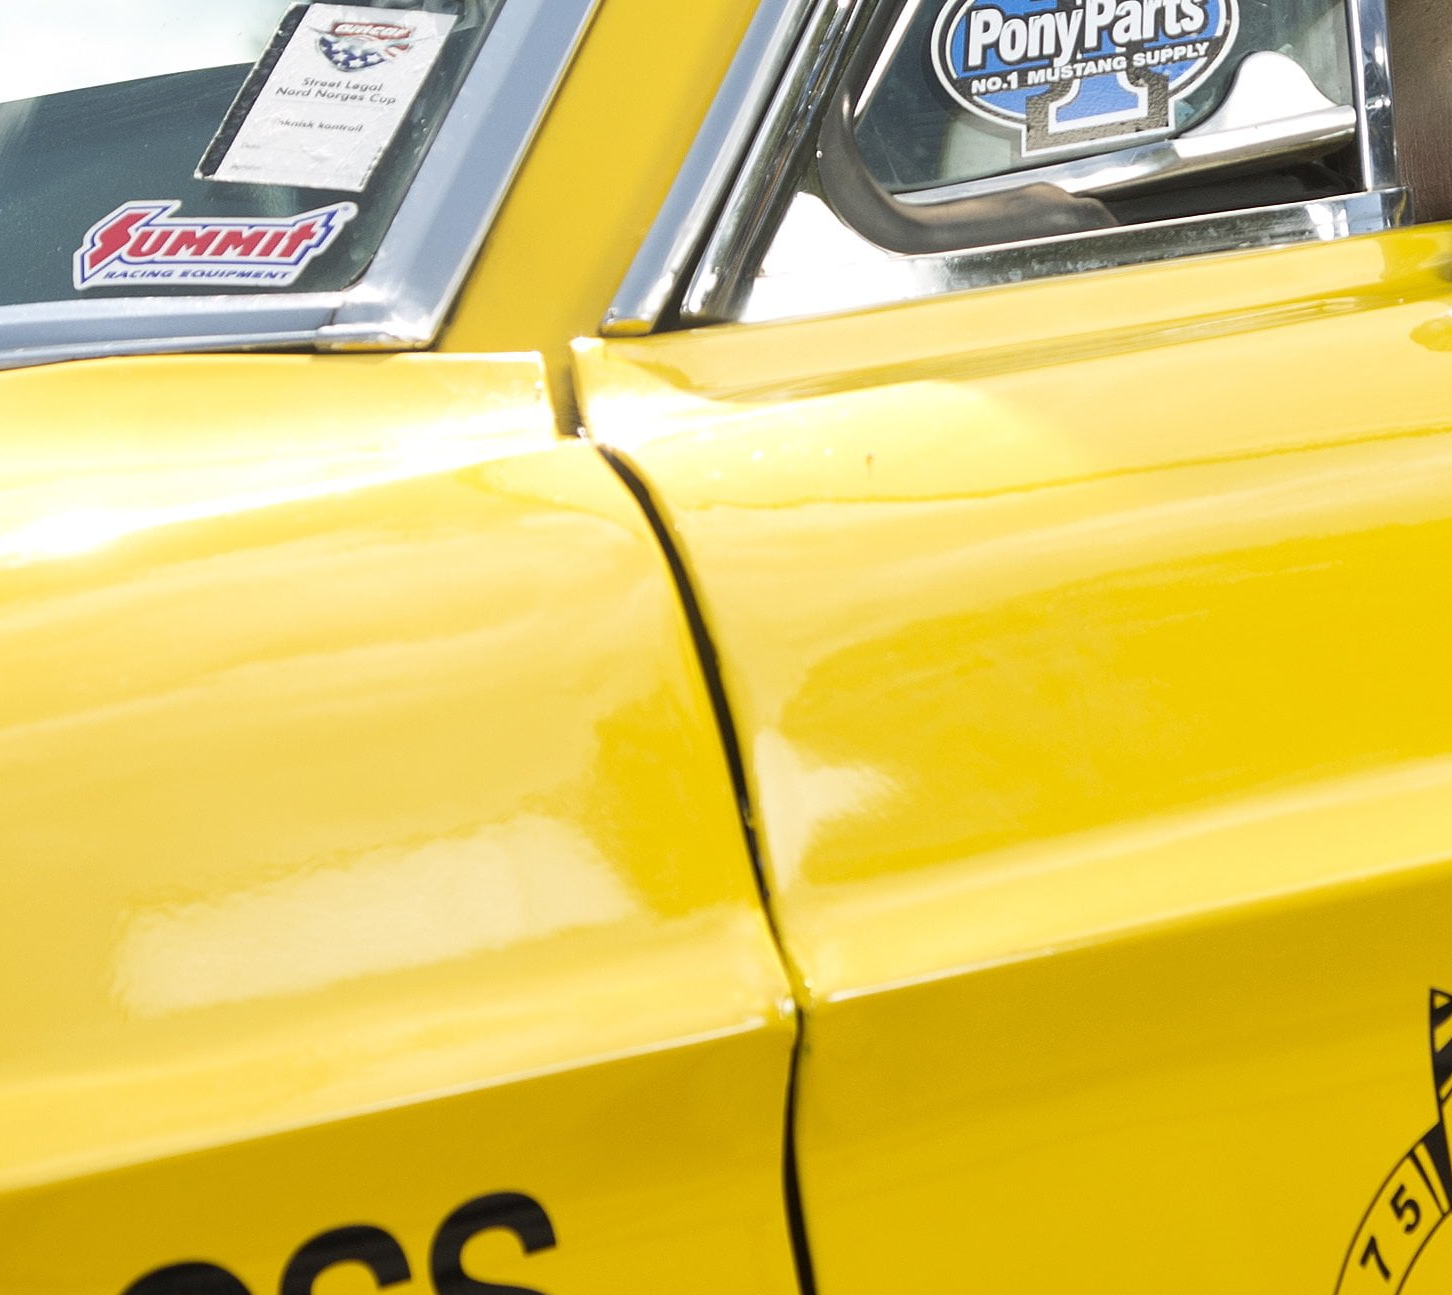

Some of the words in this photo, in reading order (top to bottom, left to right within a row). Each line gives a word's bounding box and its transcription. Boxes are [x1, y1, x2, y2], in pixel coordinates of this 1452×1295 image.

[971, 70, 1019, 95] NO.1
[1027, 57, 1127, 87] MUSTANG
[1132, 42, 1210, 68] SUPPLY
[302, 77, 341, 88] Street
[345, 81, 383, 92] Legal
[275, 87, 312, 97] Nord
[315, 89, 365, 101] Norges
[369, 93, 396, 105] Cup
[85, 209, 326, 274] SUMMIT
[104, 270, 173, 280] RACING
[180, 269, 292, 280] EQUIPMENT
